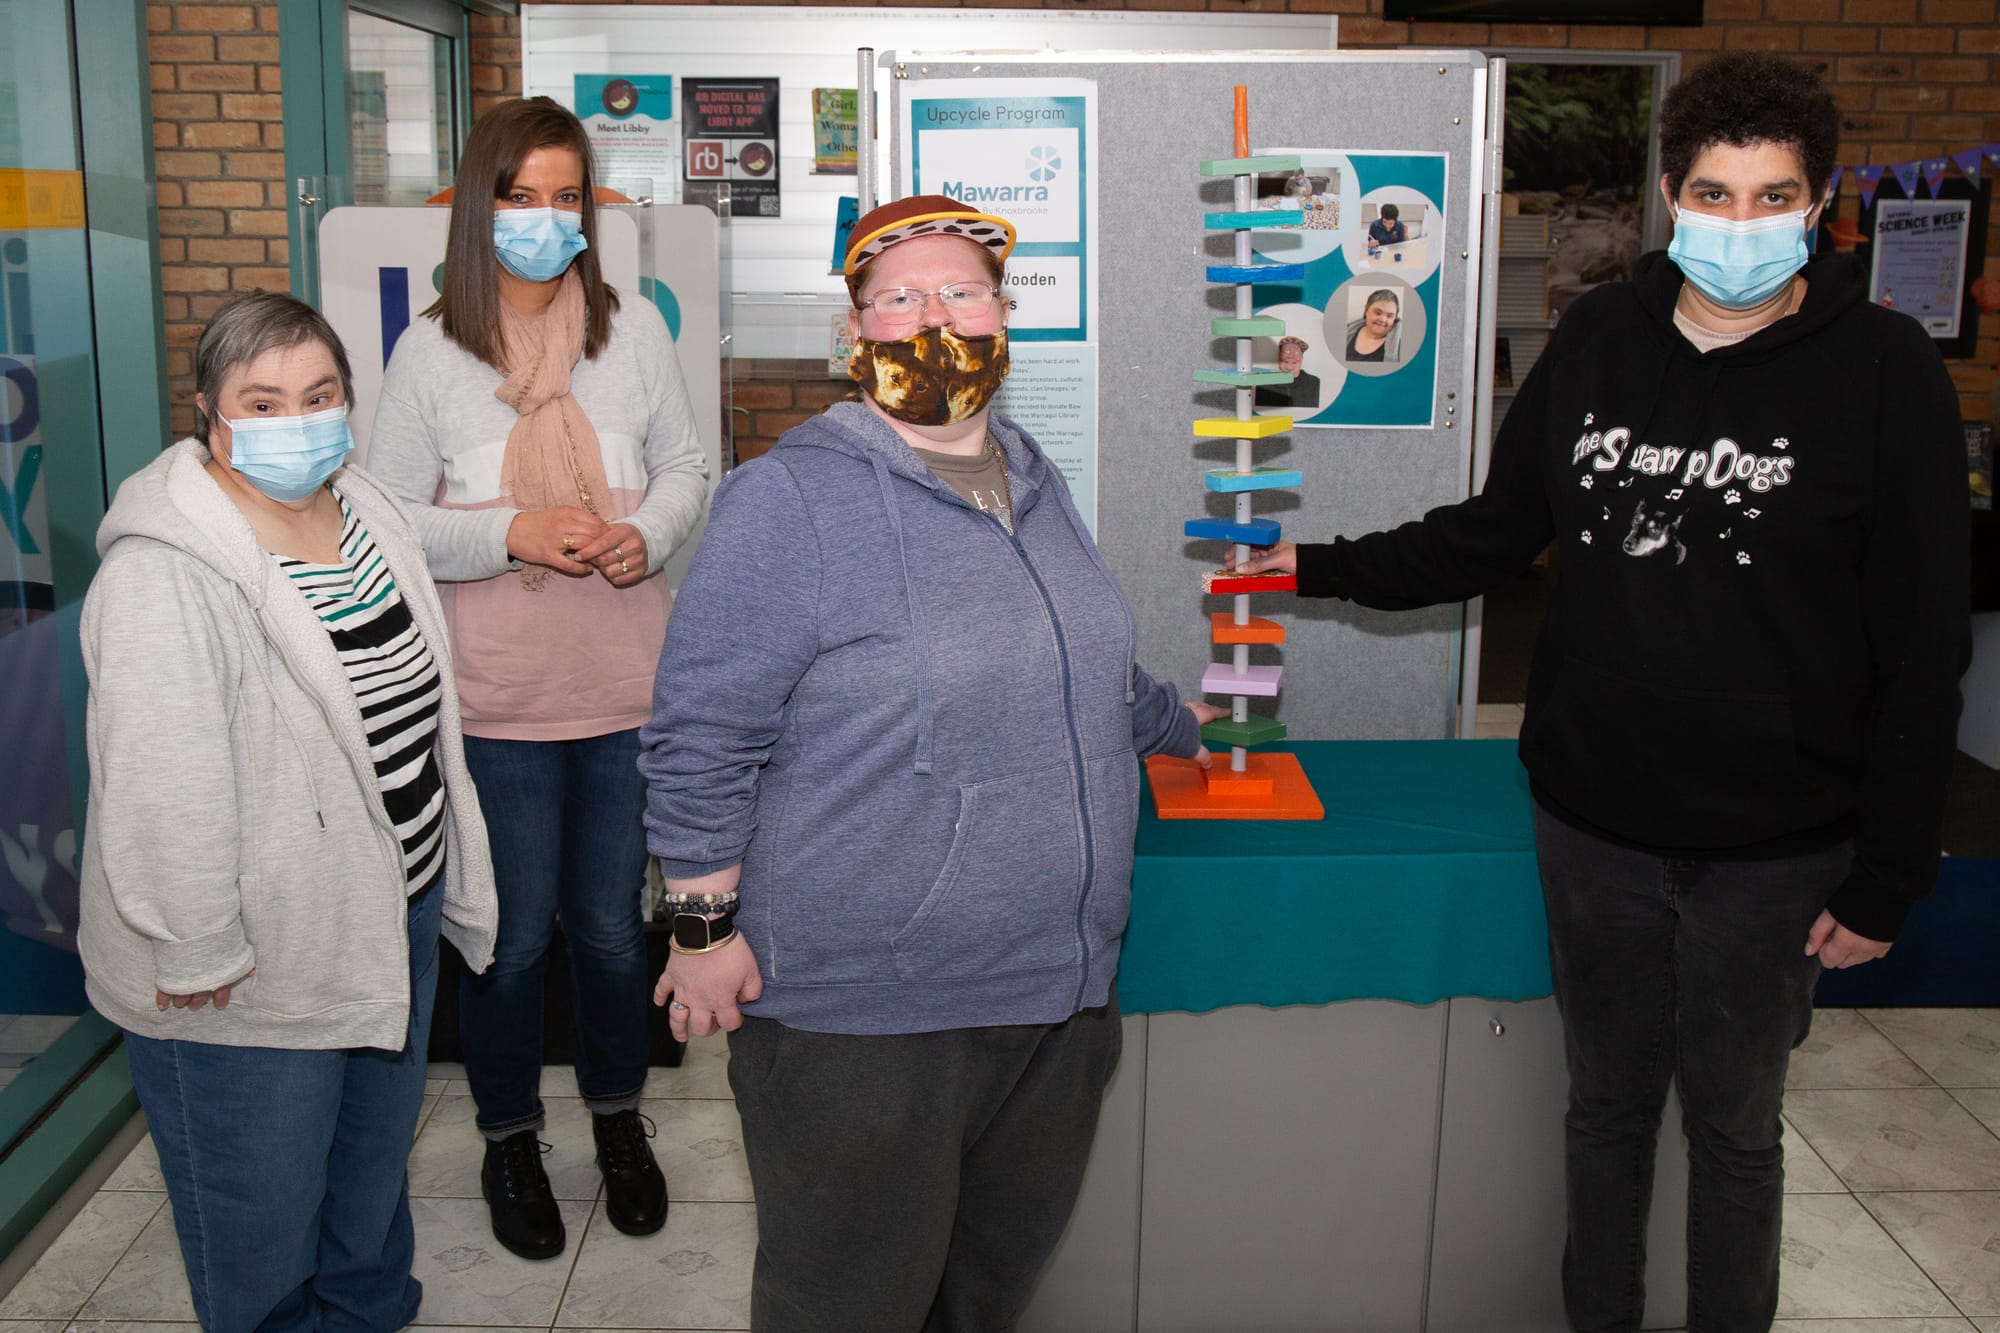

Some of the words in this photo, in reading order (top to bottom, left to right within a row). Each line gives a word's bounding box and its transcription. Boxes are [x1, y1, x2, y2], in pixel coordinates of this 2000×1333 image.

[711, 92, 745, 102] DIGITAL
[747, 92, 766, 102] HAS
[699, 104, 730, 115] MOVED
[732, 104, 743, 115] TO
[744, 104, 763, 115] THE
[927, 106, 991, 124] Upcycle
[996, 106, 1066, 125] Program
[707, 116, 733, 127] LIBBY
[735, 116, 755, 127] APP
[821, 120, 858, 131] Woma
[597, 123, 621, 133] Meet
[623, 123, 650, 135] Libby
[942, 181, 1049, 202] Mawarra
[995, 206, 1049, 215] Knoxbrooke
[1878, 215, 1929, 233] SCIENCE
[1933, 210, 1966, 227] WEEK
[1058, 412, 1080, 421] Library
